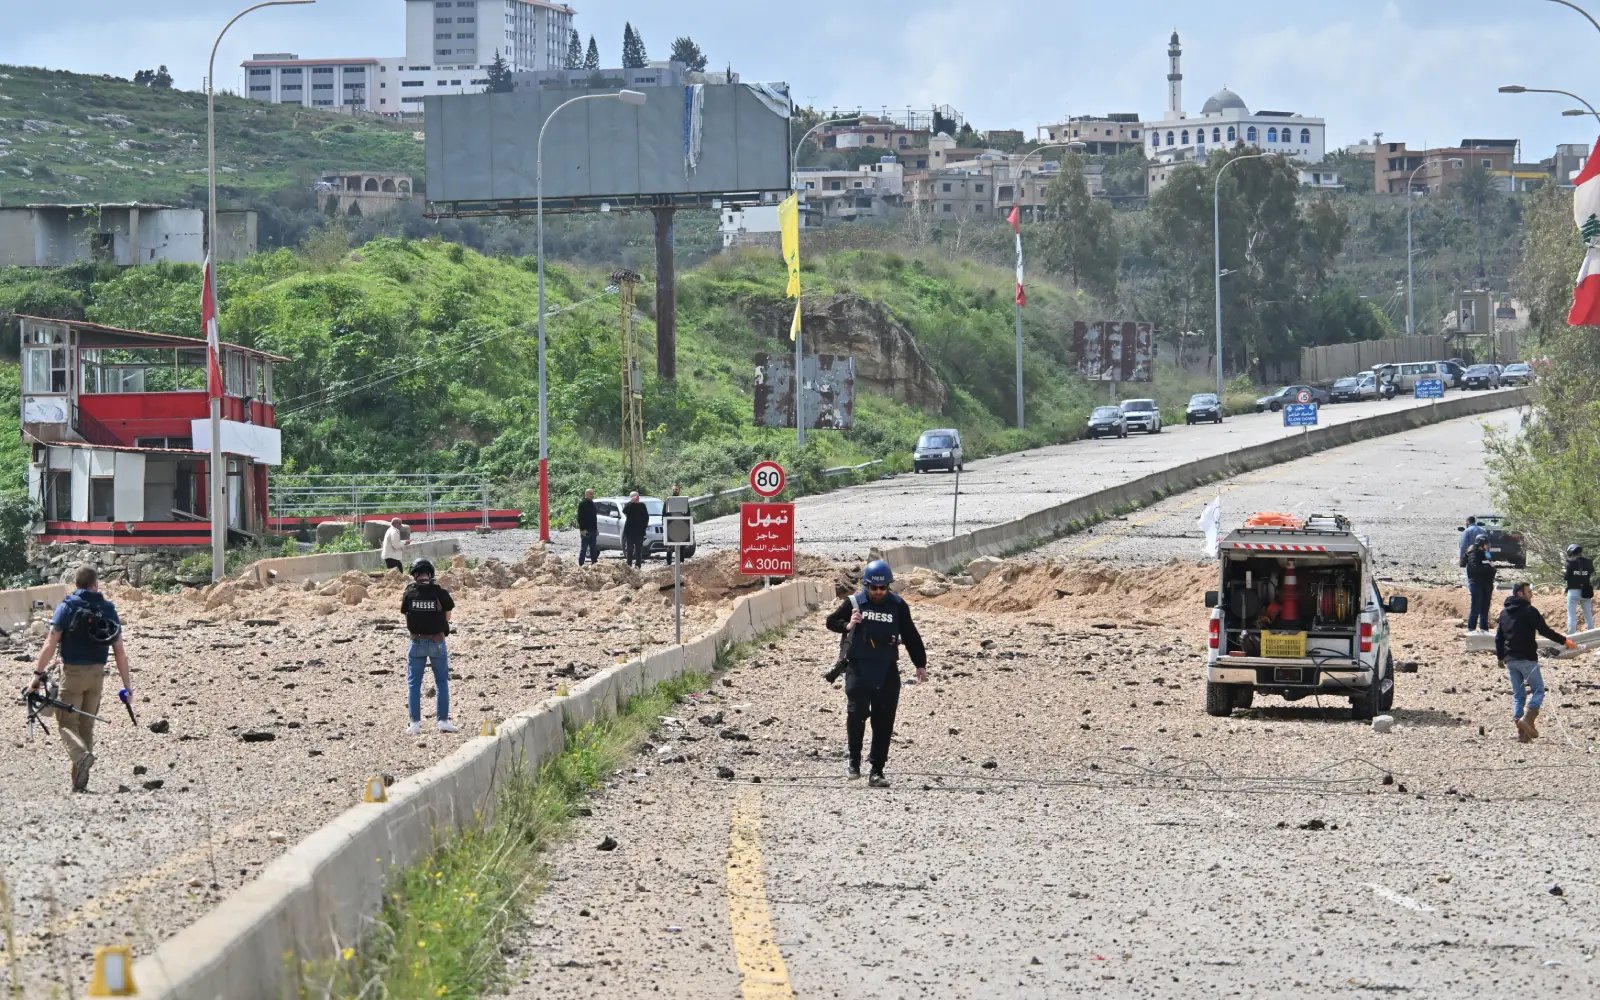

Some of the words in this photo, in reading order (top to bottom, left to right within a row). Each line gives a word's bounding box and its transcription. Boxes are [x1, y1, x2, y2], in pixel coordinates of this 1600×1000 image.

[757, 471, 779, 487] 80
[747, 508, 789, 527] تمهل
[755, 531, 779, 541] حاجز
[743, 544, 767, 555] اللبناني
[768, 544, 791, 552] الجيش
[412, 601, 436, 609] PRESSE
[862, 611, 893, 623] PRESS
